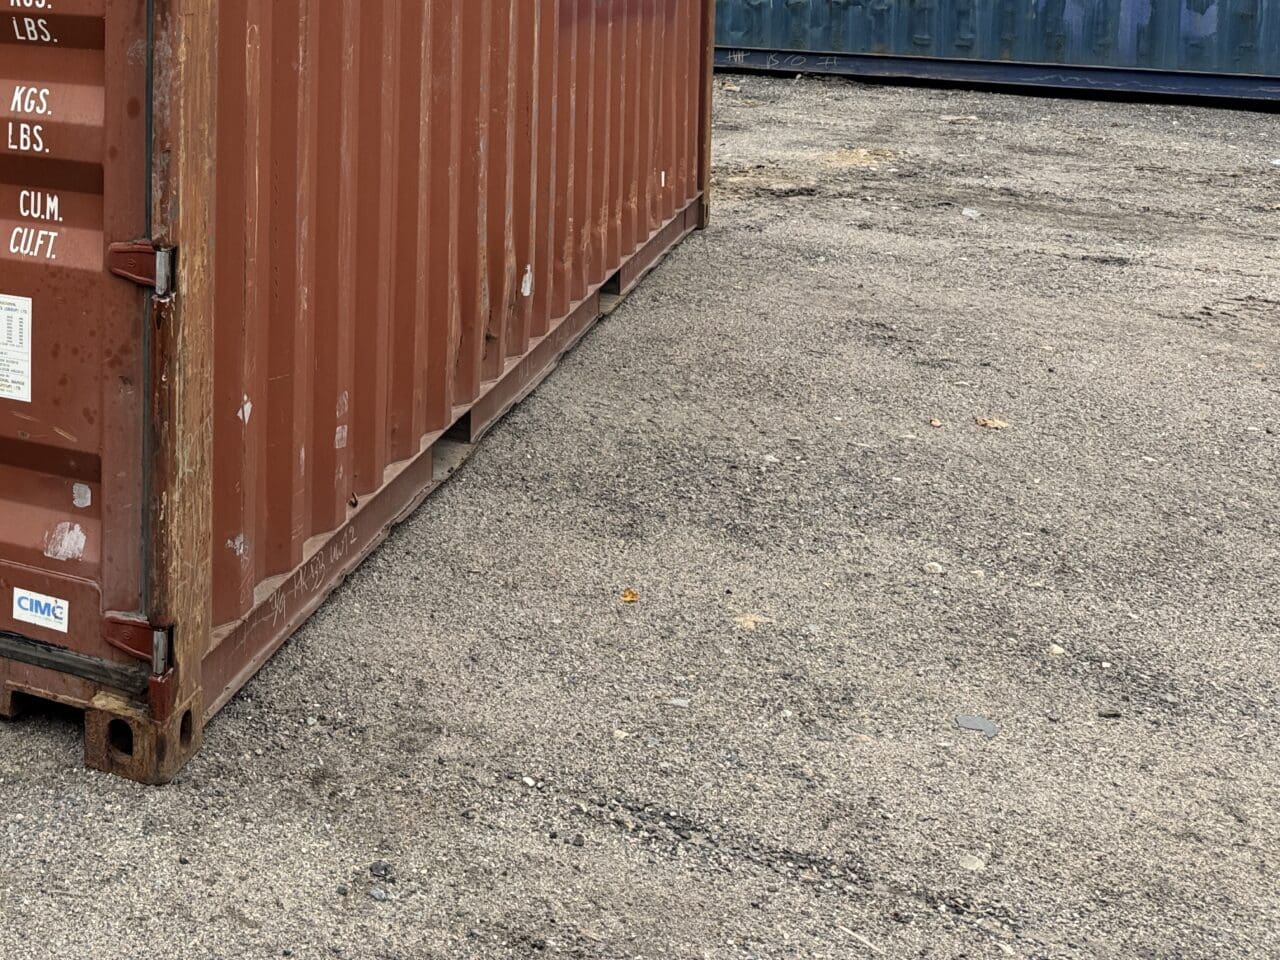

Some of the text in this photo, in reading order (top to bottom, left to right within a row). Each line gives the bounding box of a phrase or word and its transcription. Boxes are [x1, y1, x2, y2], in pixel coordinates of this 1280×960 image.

[12, 16, 58, 43] LBS.
[10, 86, 52, 115] KGS.
[7, 121, 50, 153] LBS.
[20, 190, 63, 222] CU.M.
[9, 227, 58, 259] CU.FT.
[17, 595, 64, 620] CIMC
